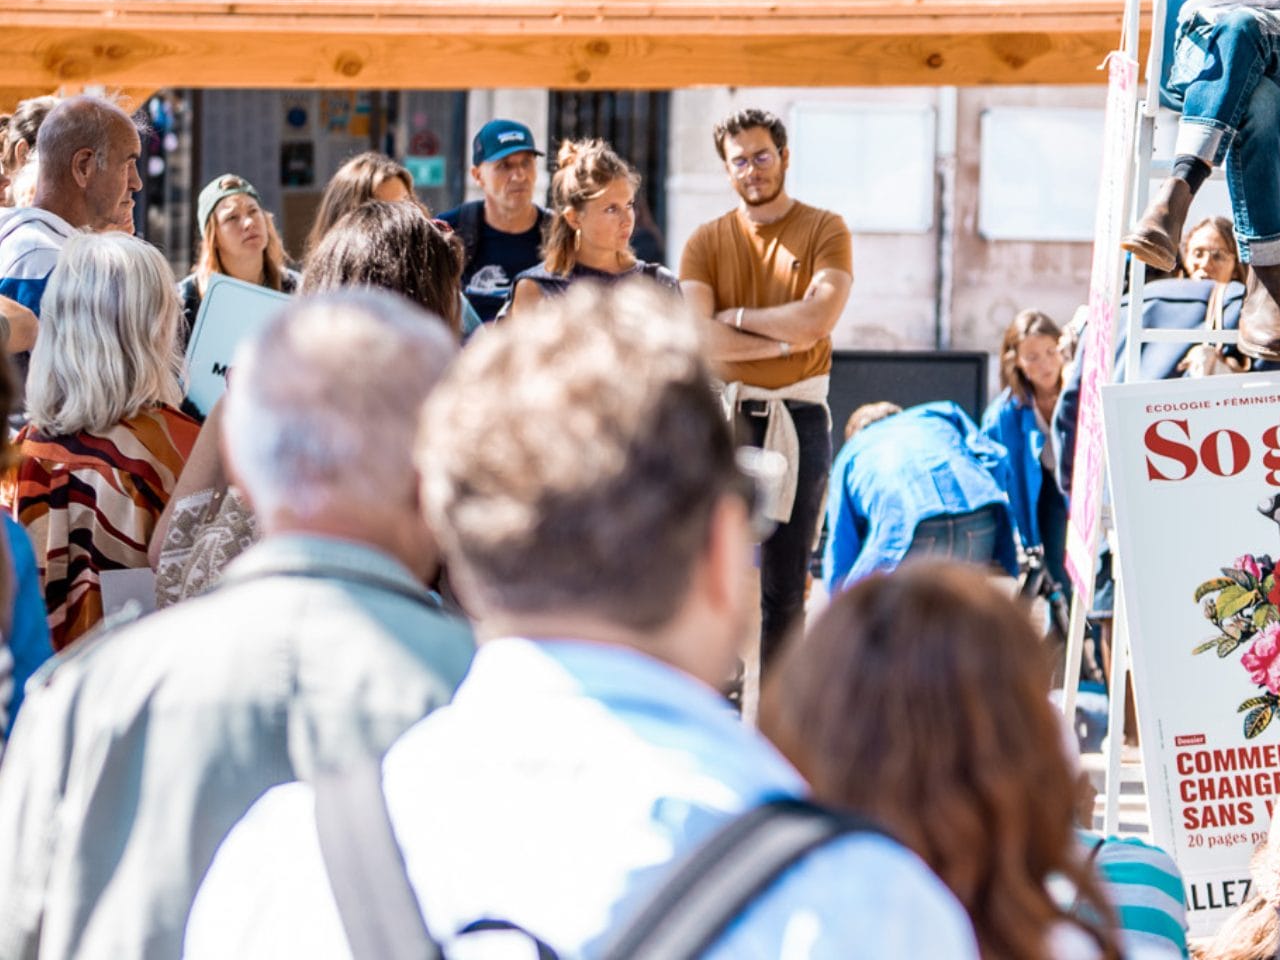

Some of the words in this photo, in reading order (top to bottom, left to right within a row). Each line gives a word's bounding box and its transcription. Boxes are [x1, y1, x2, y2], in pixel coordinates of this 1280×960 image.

[1144, 418, 1251, 481] So
[1182, 801, 1255, 830] SANS
[1187, 833, 1204, 848] 20
[1208, 831, 1248, 849] pages
[1186, 878, 1253, 911] LLEZ
